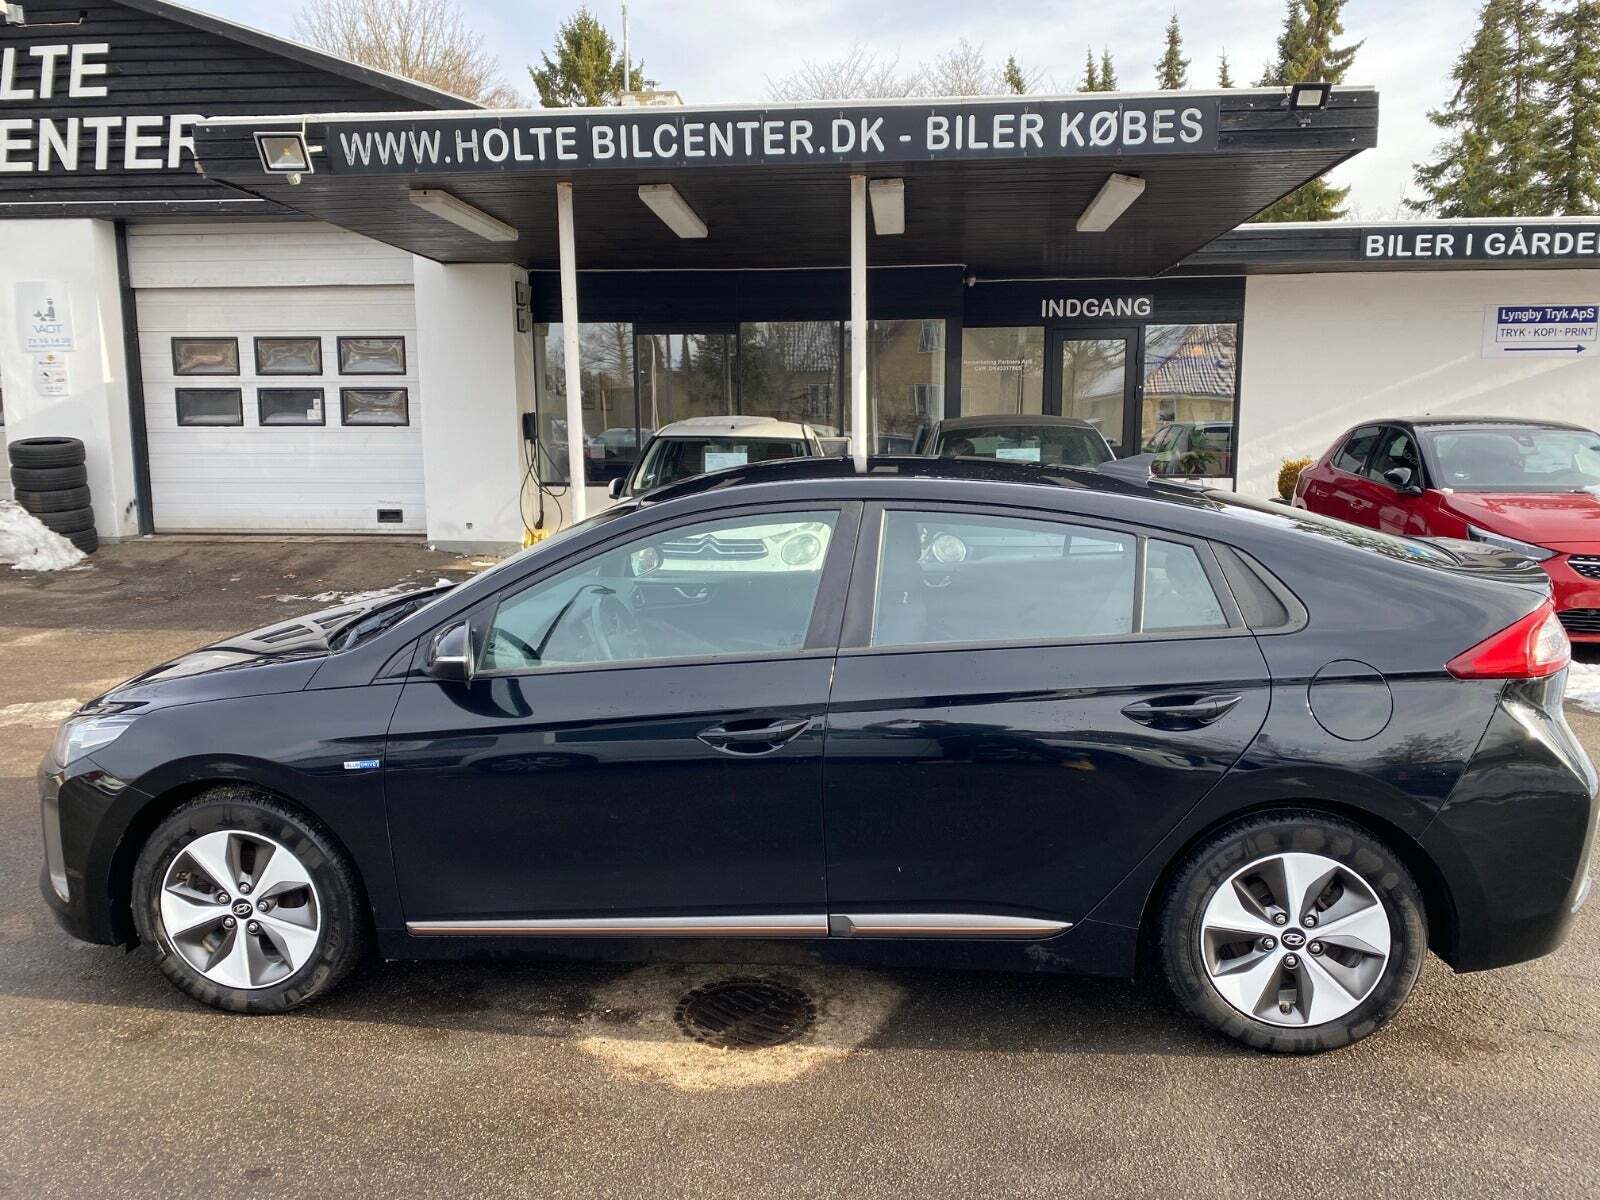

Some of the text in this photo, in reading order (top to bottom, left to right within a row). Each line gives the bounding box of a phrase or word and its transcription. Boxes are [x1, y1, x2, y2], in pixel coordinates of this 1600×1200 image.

[0, 43, 109, 100] LTE
[339, 127, 579, 166] WWW.HOLTE
[591, 117, 885, 159] BILCENTER.DK
[926, 113, 1044, 151] BILER
[1060, 107, 1203, 148] KØBES
[1365, 226, 1600, 257] BILER I GÅRDE
[1041, 297, 1151, 318] INDGANG
[1501, 308, 1595, 322] Lyngby Tryk ApS
[1500, 327, 1595, 337] TRYK KOPI PRINT
